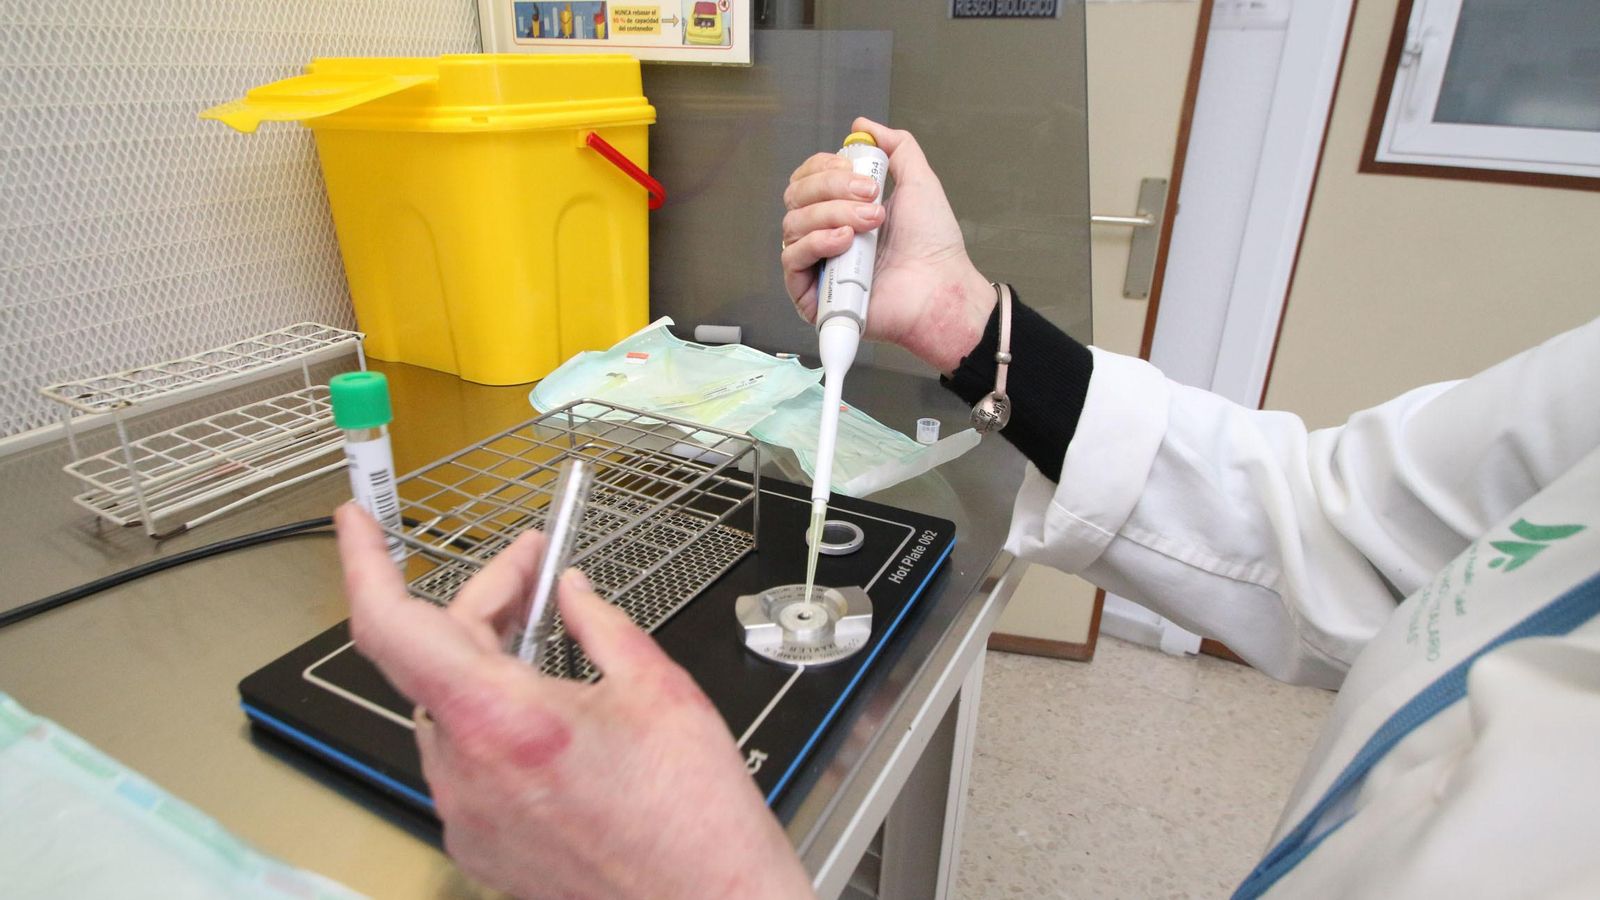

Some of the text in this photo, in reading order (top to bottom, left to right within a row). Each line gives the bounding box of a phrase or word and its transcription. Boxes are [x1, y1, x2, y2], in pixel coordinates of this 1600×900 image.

[888, 530, 938, 584] Hot Plate 062
